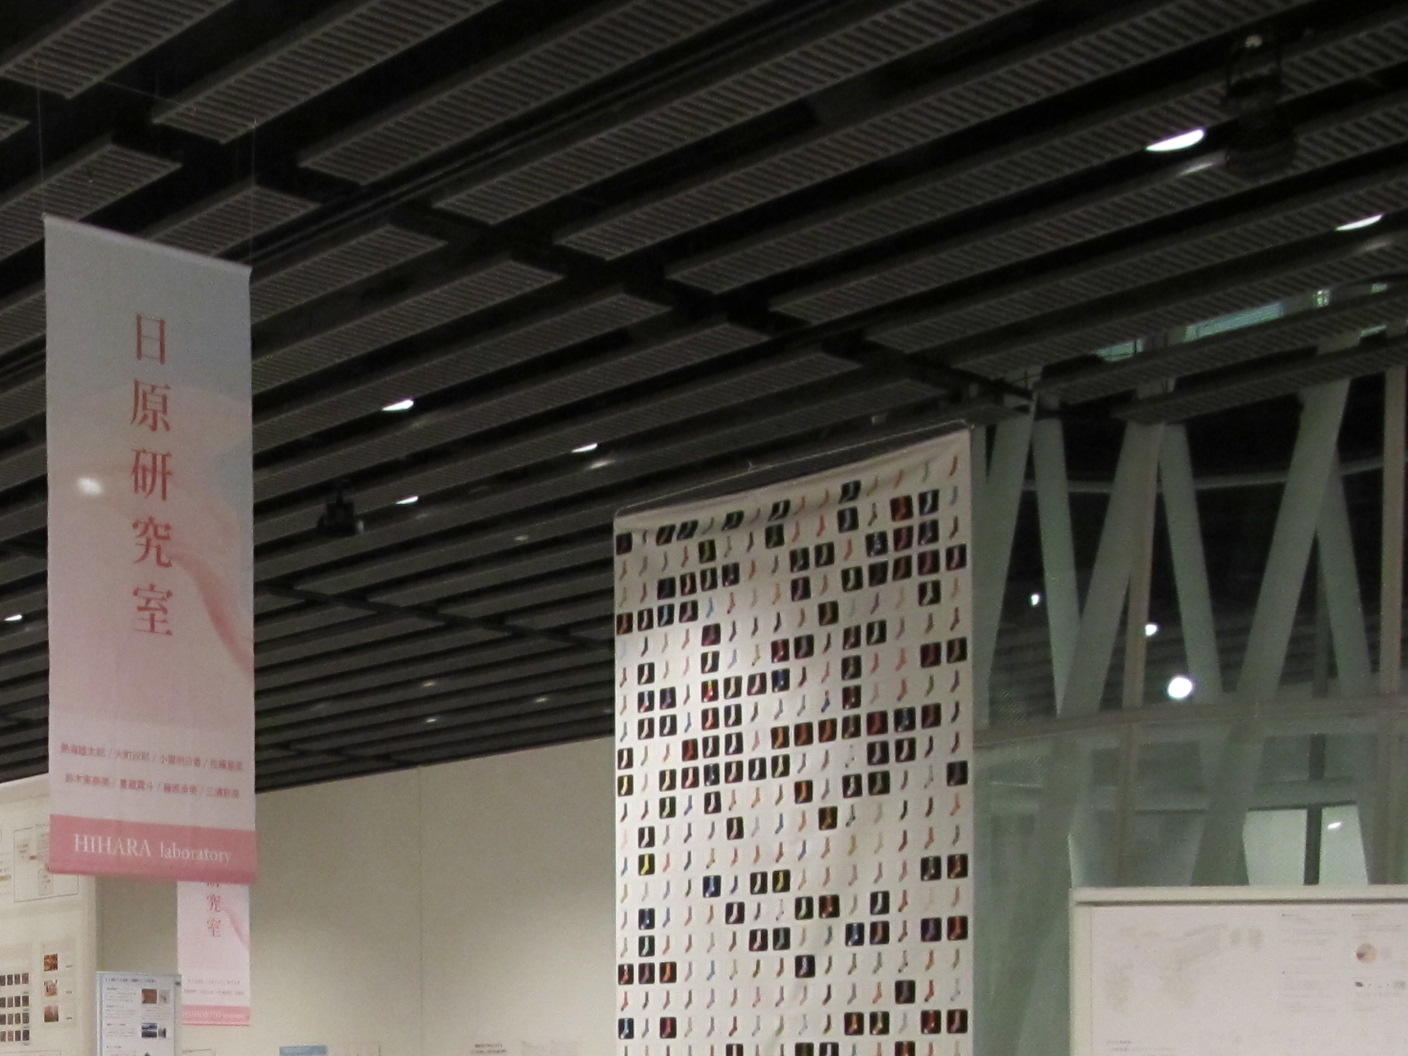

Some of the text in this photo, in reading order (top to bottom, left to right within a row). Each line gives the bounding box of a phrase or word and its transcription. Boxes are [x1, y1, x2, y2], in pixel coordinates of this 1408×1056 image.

[130, 313, 173, 637] 日原研究室
[73, 832, 233, 865] HIHARA laboratory
